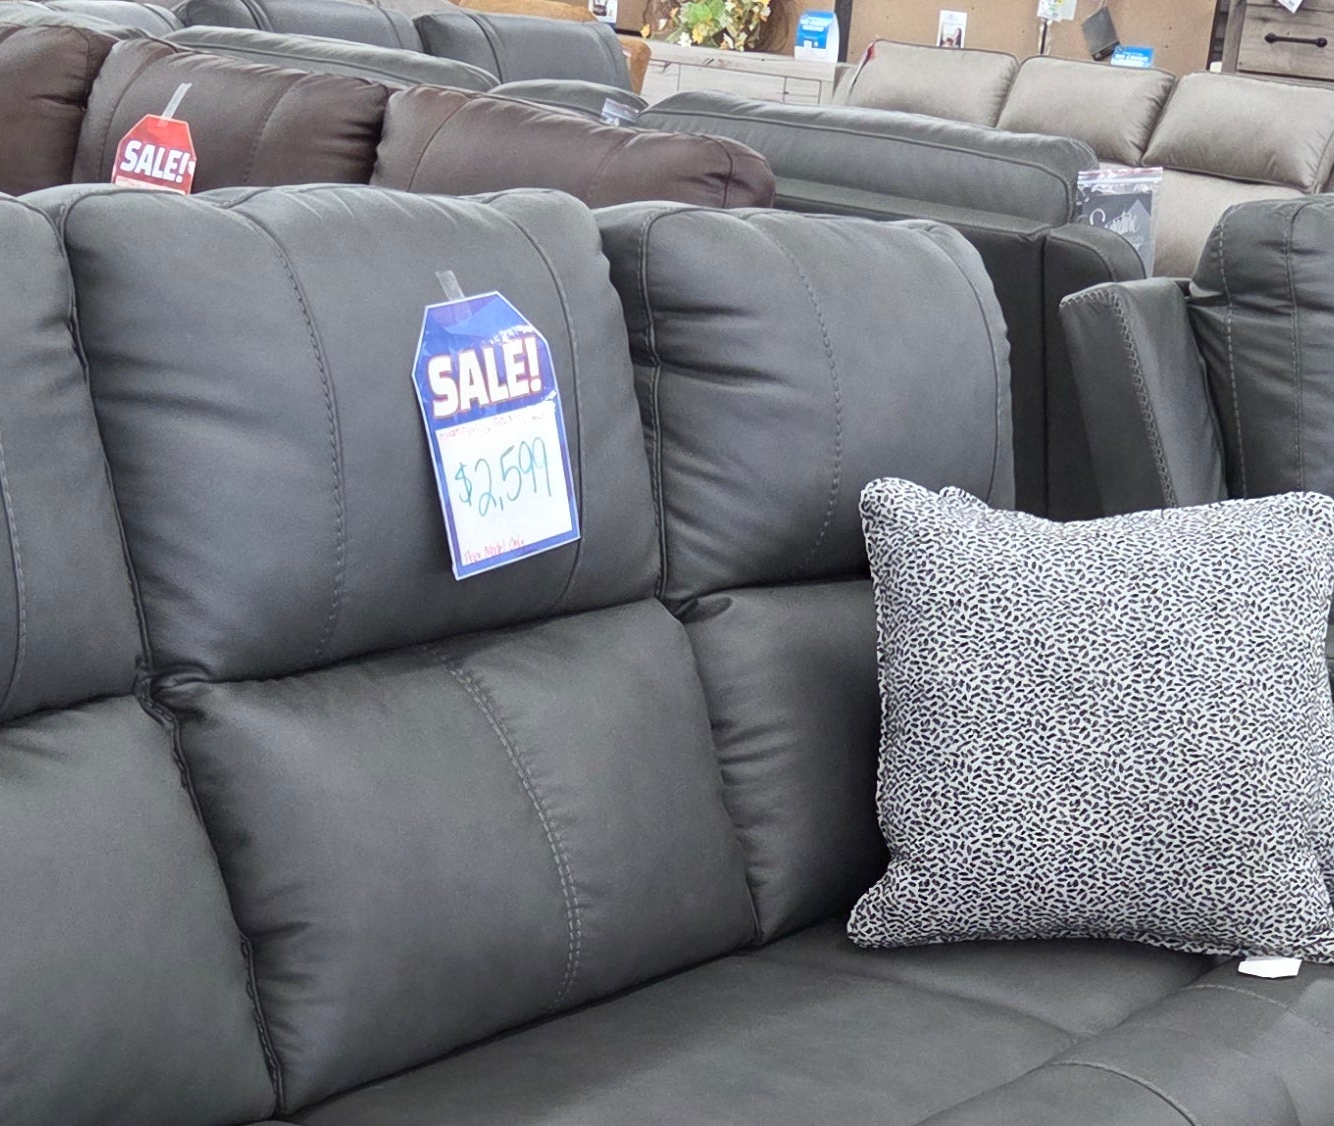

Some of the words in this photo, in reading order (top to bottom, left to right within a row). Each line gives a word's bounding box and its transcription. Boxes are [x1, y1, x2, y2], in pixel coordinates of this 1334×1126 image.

[120, 140, 190, 183] SALE!
[427, 336, 543, 418] SALE!
[454, 436, 552, 517] $2,599
